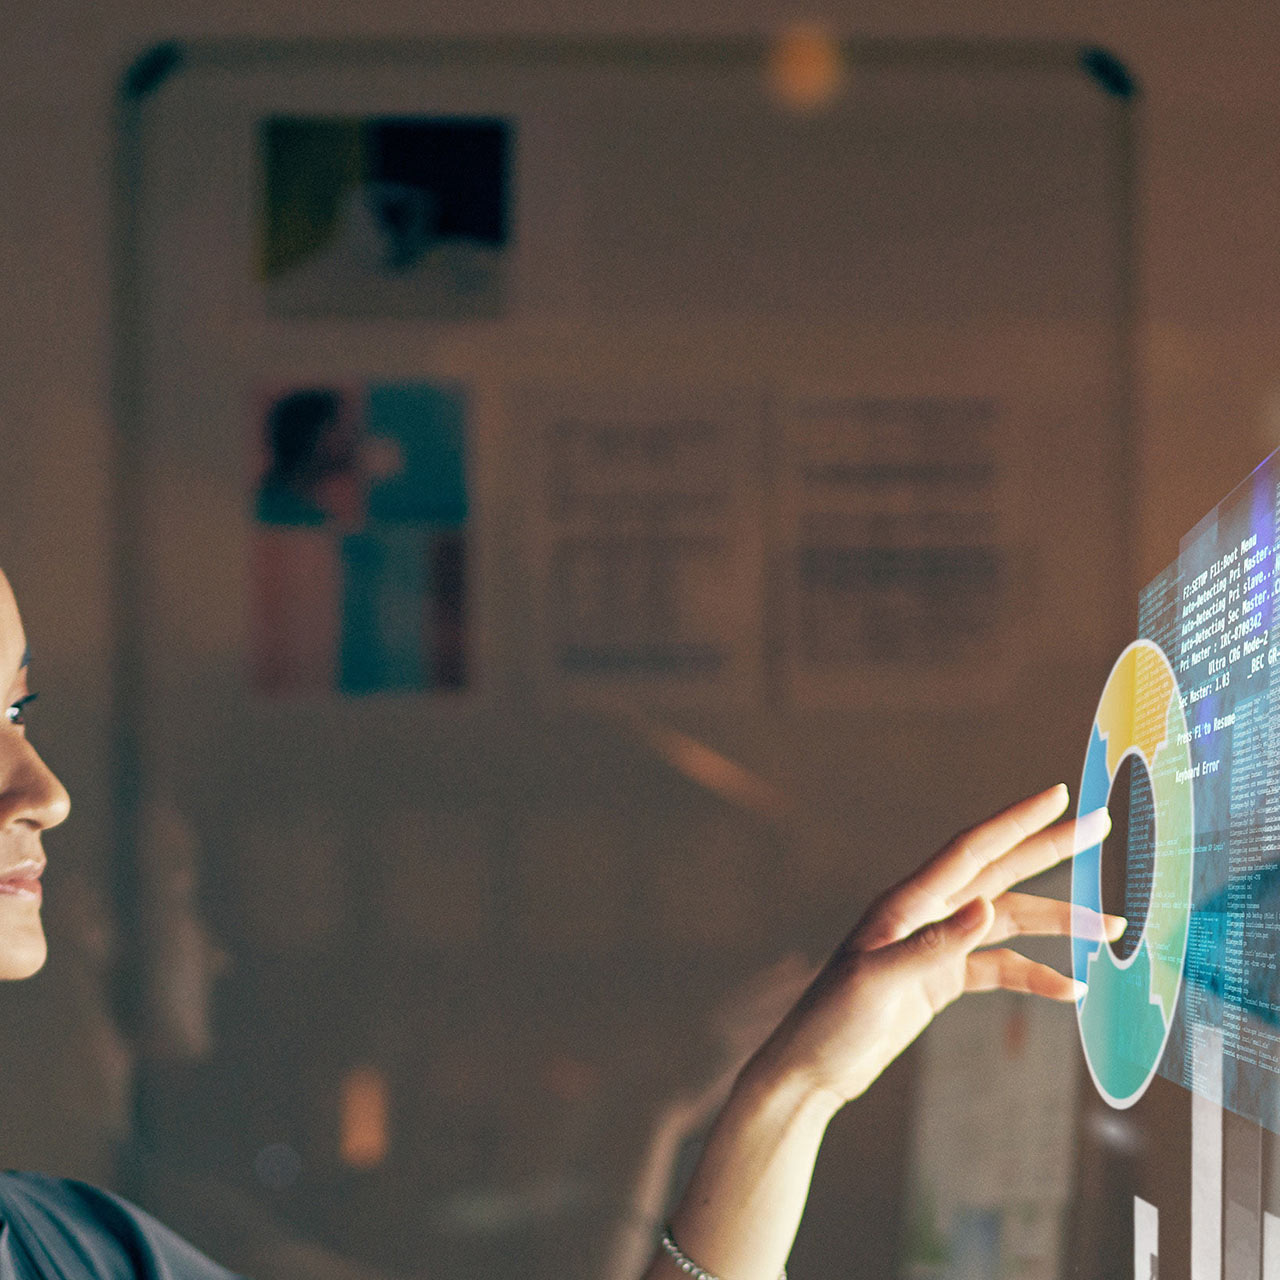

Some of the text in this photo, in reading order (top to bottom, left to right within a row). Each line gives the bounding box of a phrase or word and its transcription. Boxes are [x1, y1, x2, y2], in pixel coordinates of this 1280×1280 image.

[1240, 533, 1257, 555] Menu
[1182, 574, 1227, 618] Auto-Detecting
[1229, 563, 1241, 582] Pri
[1181, 593, 1226, 637] Auto-Detecting
[1228, 581, 1241, 602] Pri
[1180, 612, 1226, 655] Auto-Detecting
[1227, 603, 1240, 622] Sec
[1179, 655, 1190, 674] Pri
[1191, 645, 1212, 666] Master
[1208, 655, 1226, 676] Ultra
[1176, 712, 1236, 746] Press F1 to Resume
[1175, 759, 1220, 784] Keyboard Error
